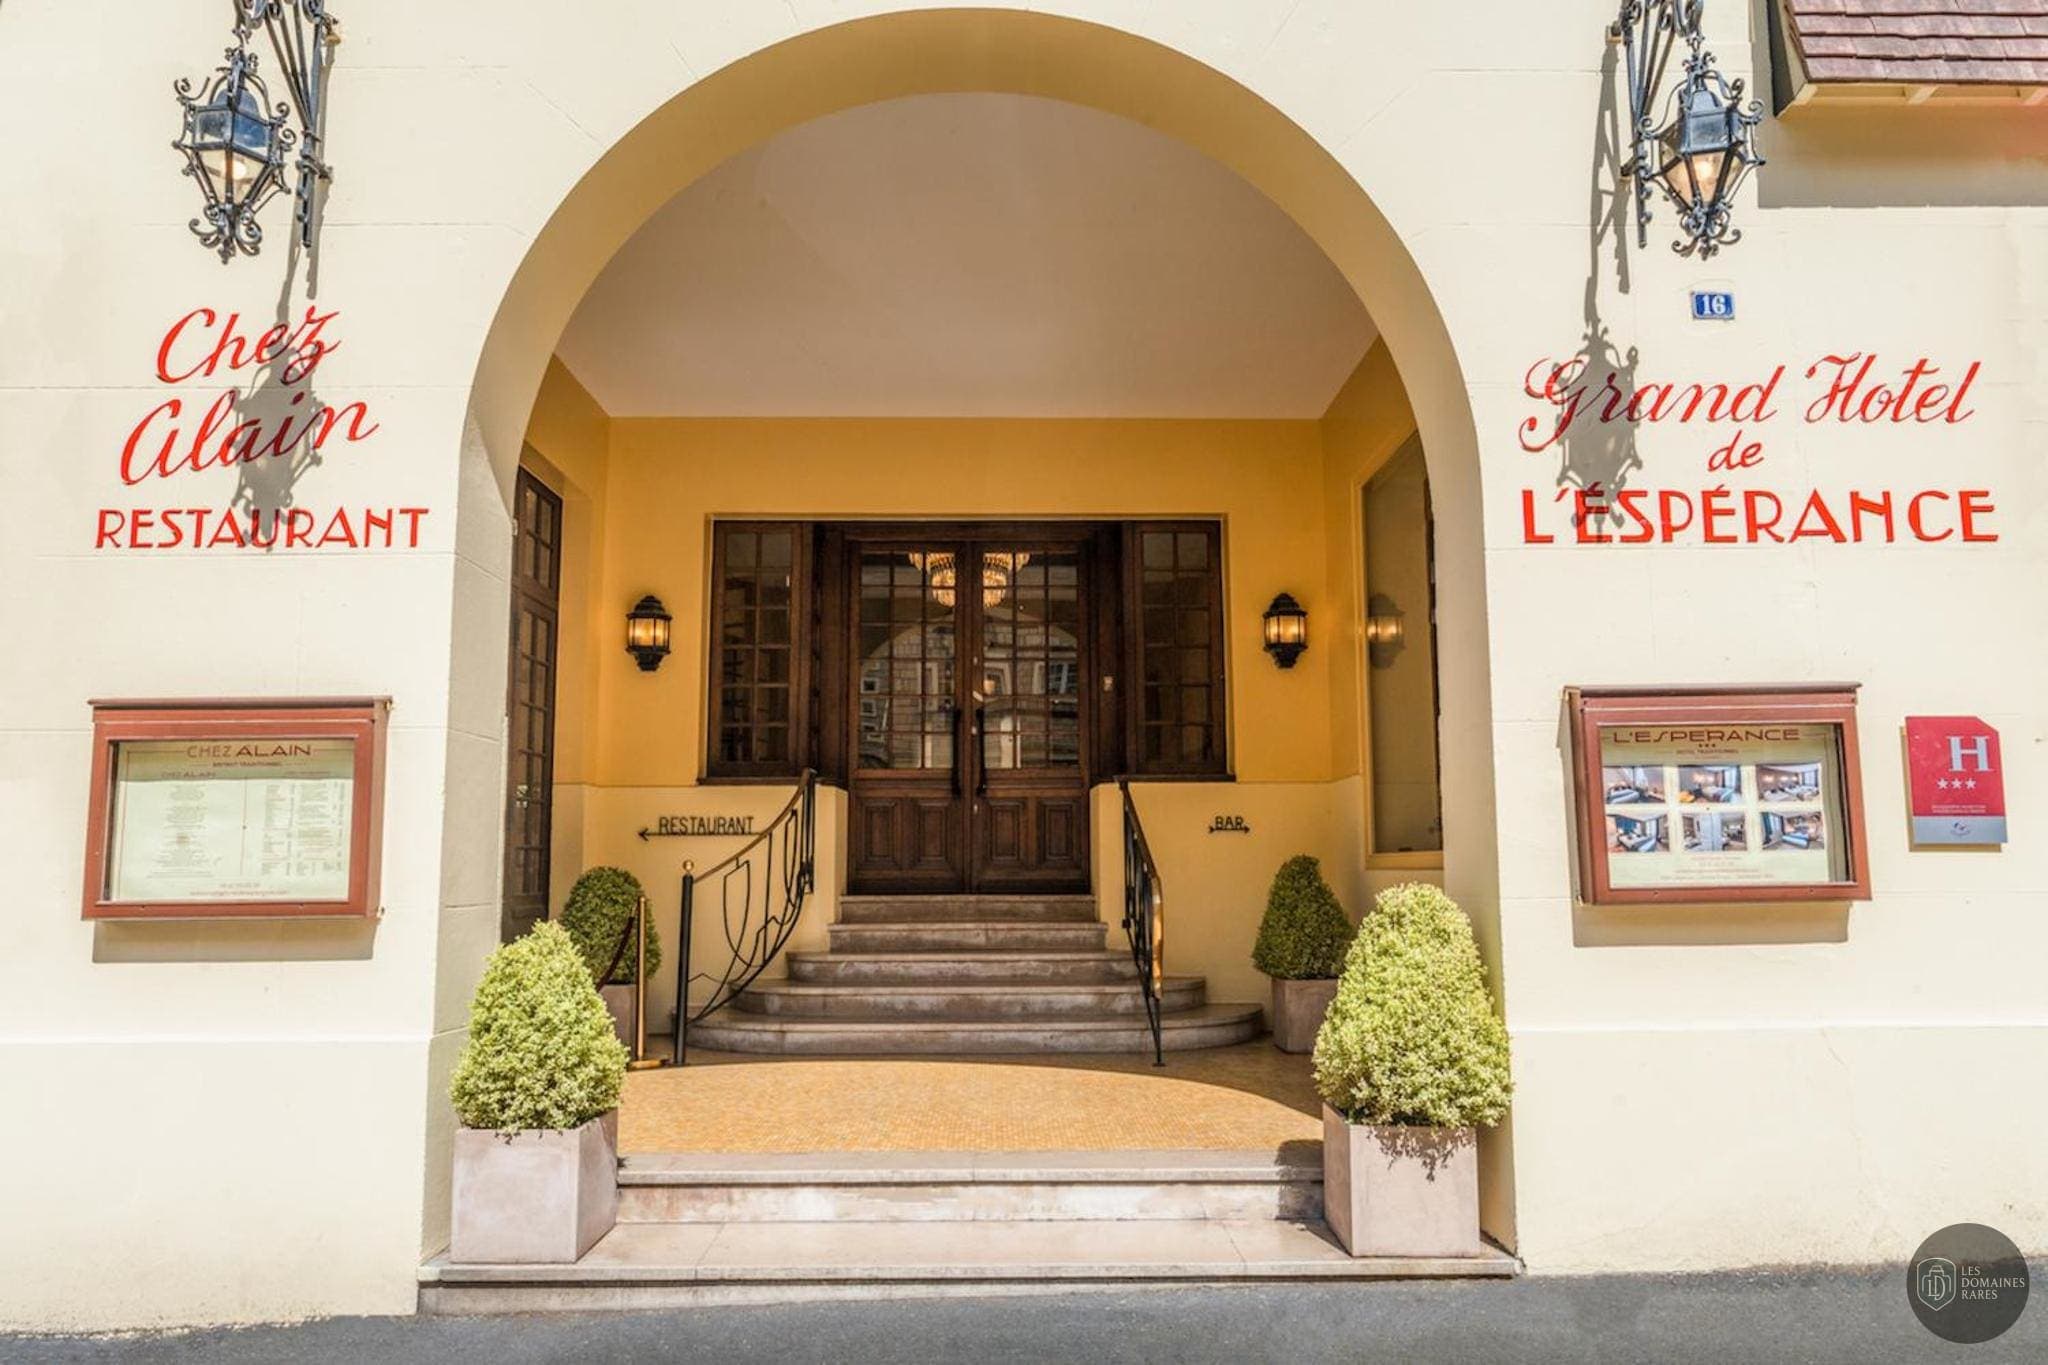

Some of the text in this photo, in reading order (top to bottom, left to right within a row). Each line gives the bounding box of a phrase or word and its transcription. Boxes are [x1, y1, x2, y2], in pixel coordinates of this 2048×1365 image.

[1702, 294, 1727, 315] 16
[155, 304, 342, 386] Chez
[1518, 351, 1981, 452] Grand Hotel
[119, 388, 381, 486] Alain
[1707, 429, 1765, 472] de
[94, 507, 430, 549] RESTAURANT
[186, 744, 312, 759] CHEZ ALAIN
[1613, 728, 1801, 744] L'ESPERANCE
[1945, 735, 1995, 773] H
[658, 815, 755, 836] RESTAURANT
[1214, 815, 1245, 831] BAR
